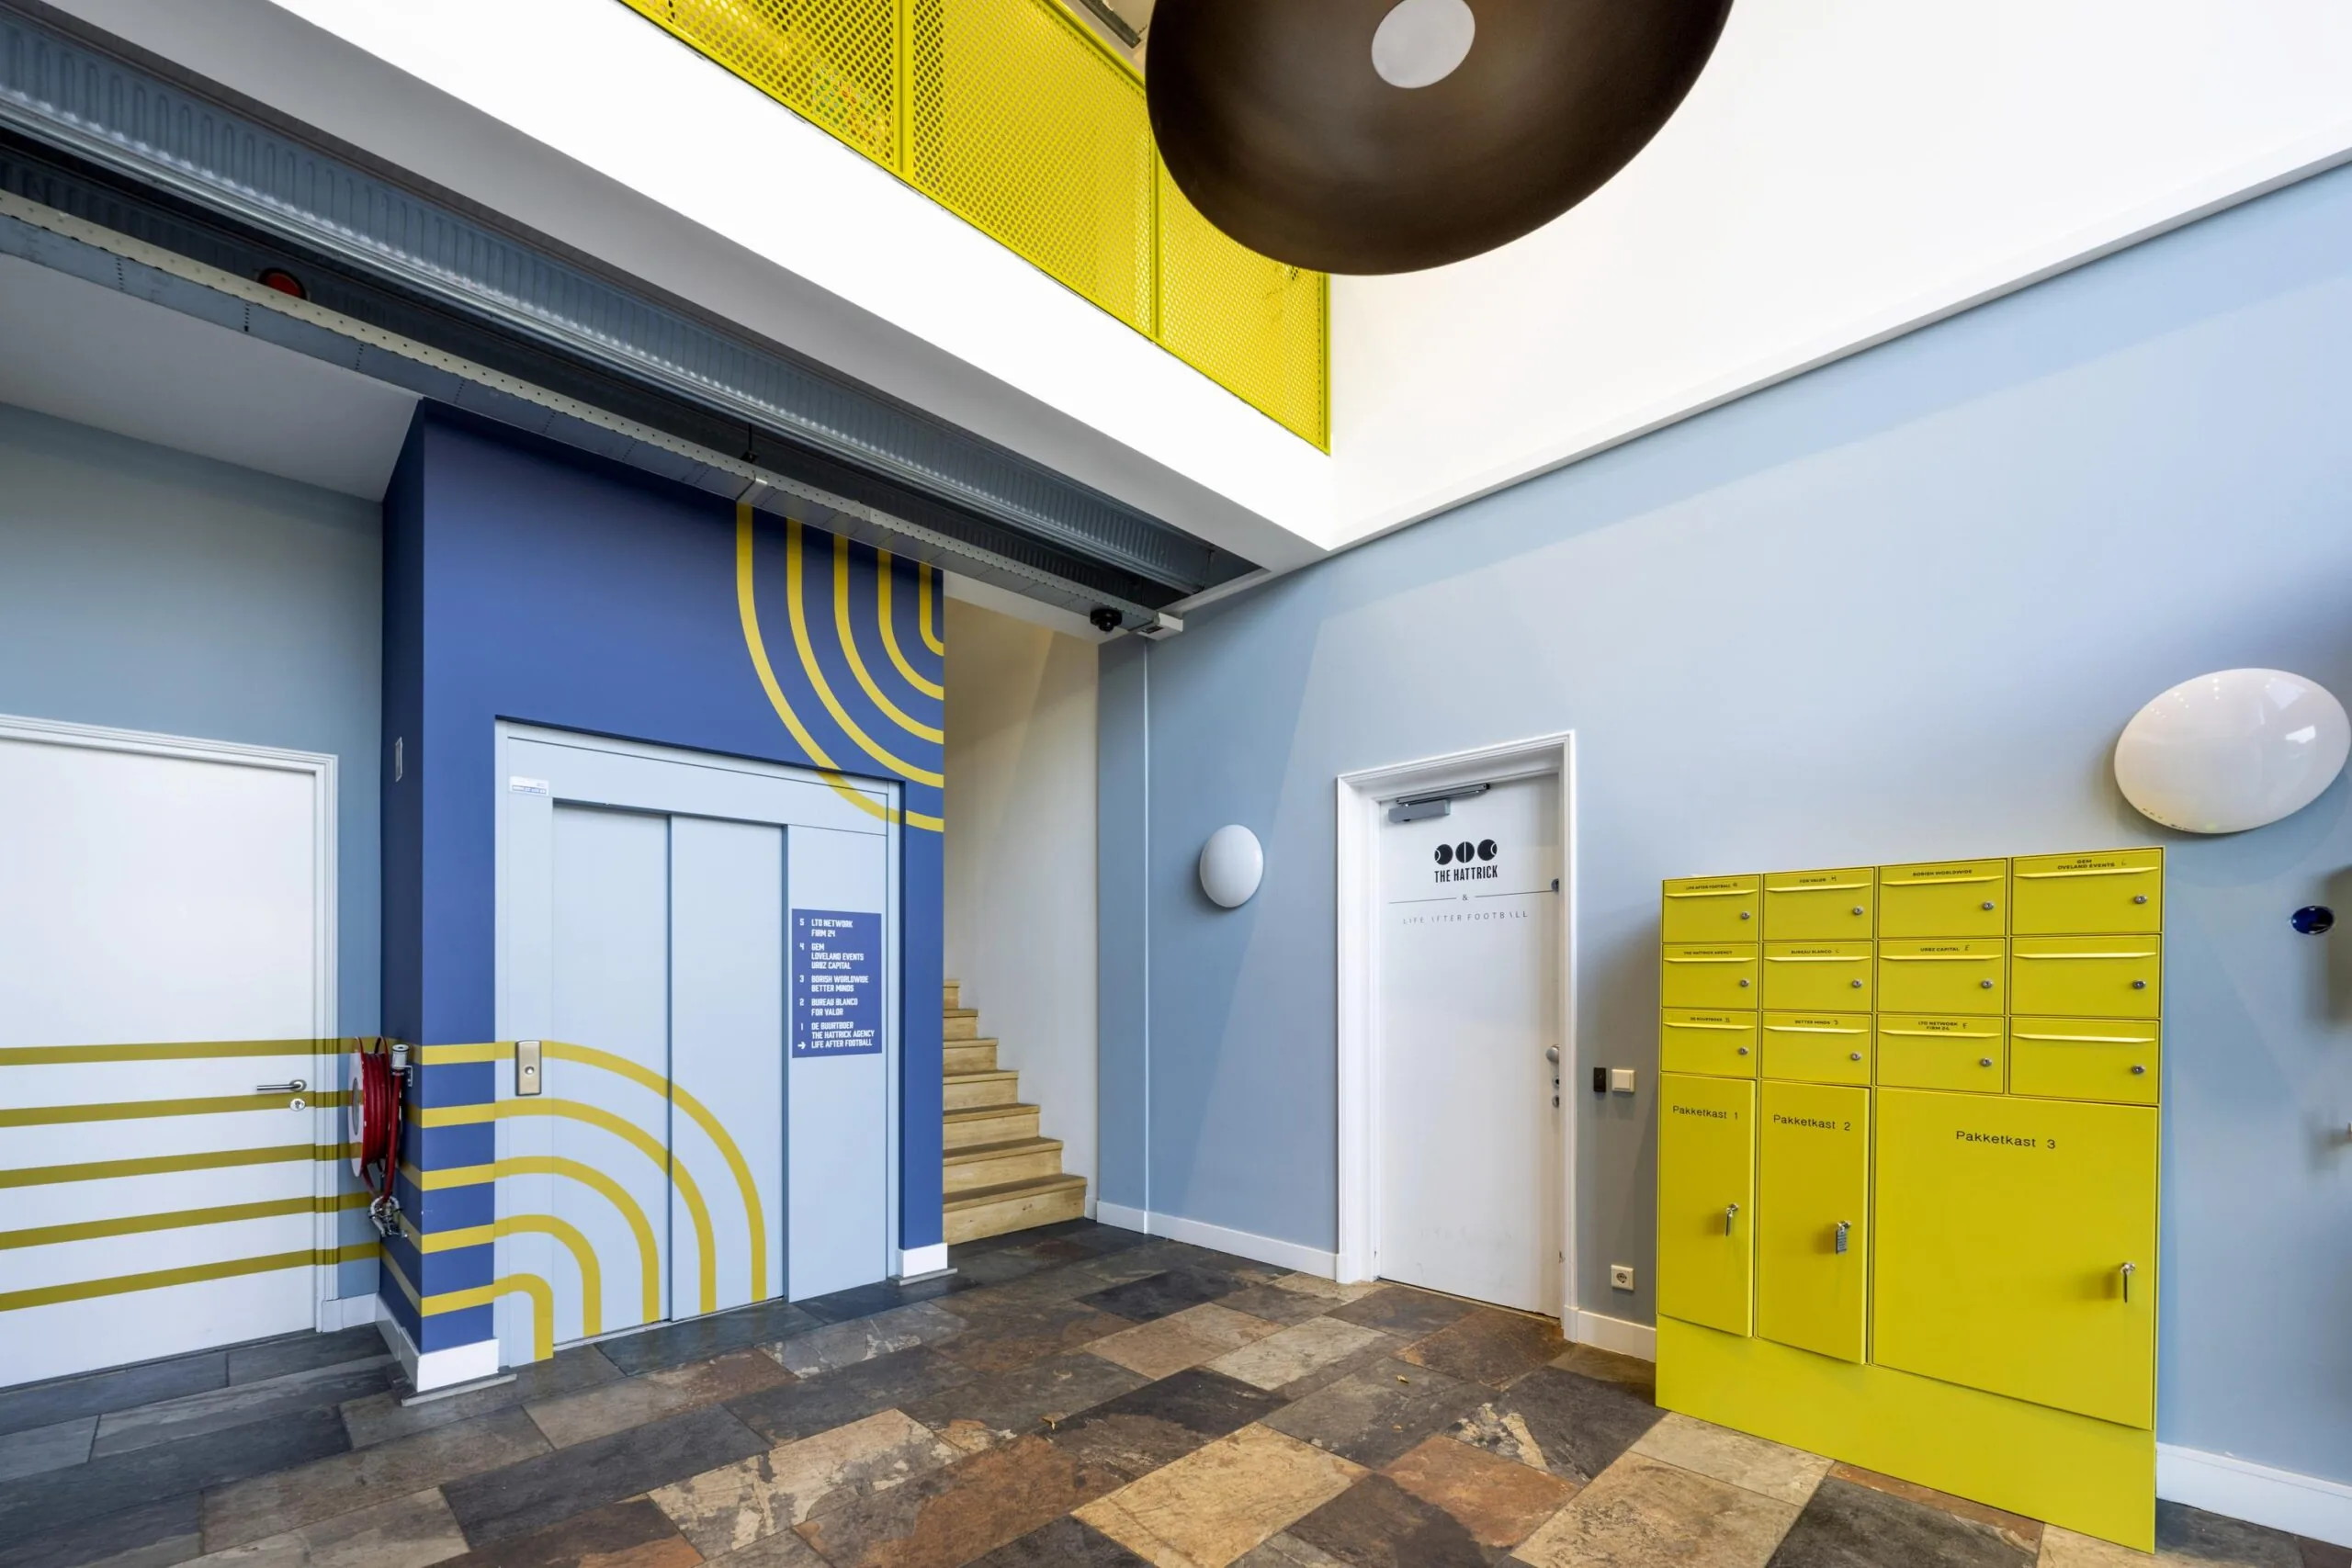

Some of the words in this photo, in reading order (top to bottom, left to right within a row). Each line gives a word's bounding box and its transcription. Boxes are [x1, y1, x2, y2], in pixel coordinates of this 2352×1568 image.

[1434, 870, 1451, 883] THE
[1453, 865, 1498, 881] HATTRICK
[823, 919, 853, 928] NETWORK
[799, 942, 804, 951] 4
[811, 942, 825, 951] GEM
[811, 952, 841, 960] LOVELAND
[828, 961, 852, 970] CAPITAL
[811, 984, 834, 993] BETTER
[835, 984, 854, 993] MINDS
[811, 998, 835, 1006] BUREAU
[835, 998, 859, 1006] BLANCO
[811, 1008, 823, 1016] FOR
[824, 1008, 844, 1016] VALOR
[811, 1022, 820, 1030] DE
[811, 1031, 823, 1039] THE
[824, 1030, 852, 1038] HATTRICK
[853, 1030, 875, 1038] AGENCY
[811, 1040, 825, 1049] LIFE
[825, 1039, 844, 1048] AFTER
[845, 1038, 873, 1047] FOOTBALL
[1672, 1105, 1727, 1120] Pakketkast
[1734, 1111, 1738, 1121] 1
[1773, 1114, 1836, 1130] Pakketkast
[1844, 1122, 1851, 1132] 2
[1955, 1130, 2036, 1148] Pakketkast
[2047, 1139, 2056, 1150] 3
